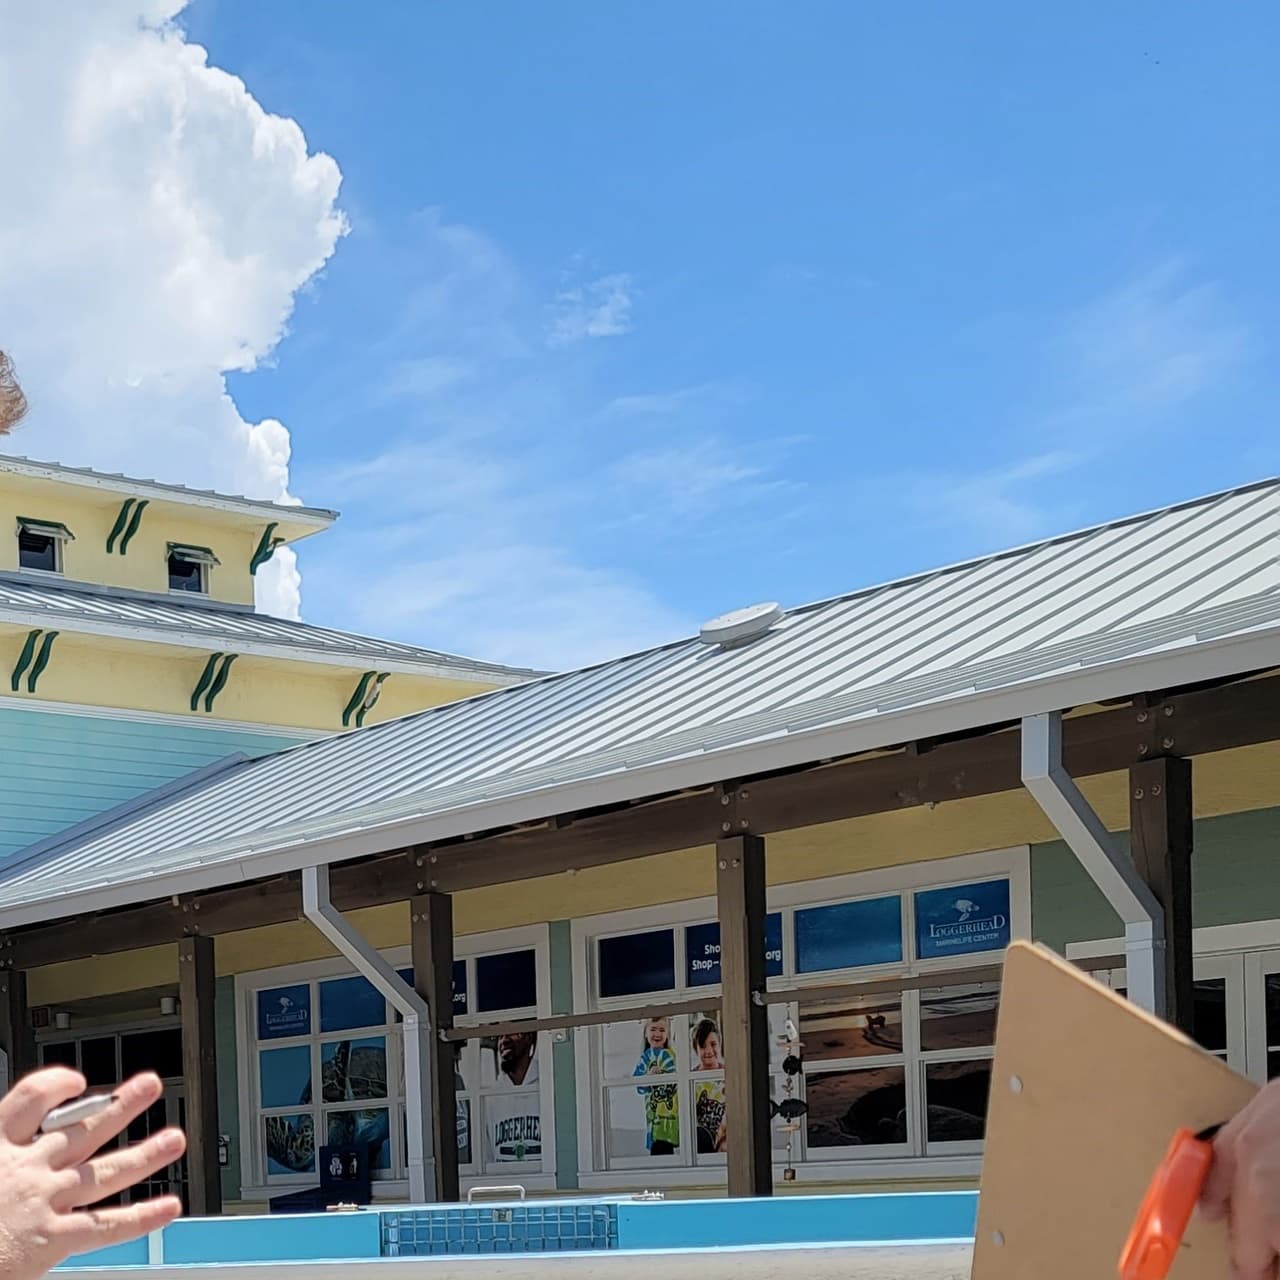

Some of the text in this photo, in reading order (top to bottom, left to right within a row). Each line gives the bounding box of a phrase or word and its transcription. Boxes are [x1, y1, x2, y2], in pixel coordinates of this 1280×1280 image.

[930, 914, 1006, 938] LOGGERHEAD
[973, 932, 1000, 942] CENTER
[704, 944, 721, 955] Sho
[692, 950, 781, 971] Shop- org
[495, 1115, 541, 1147] LOGGERHE
